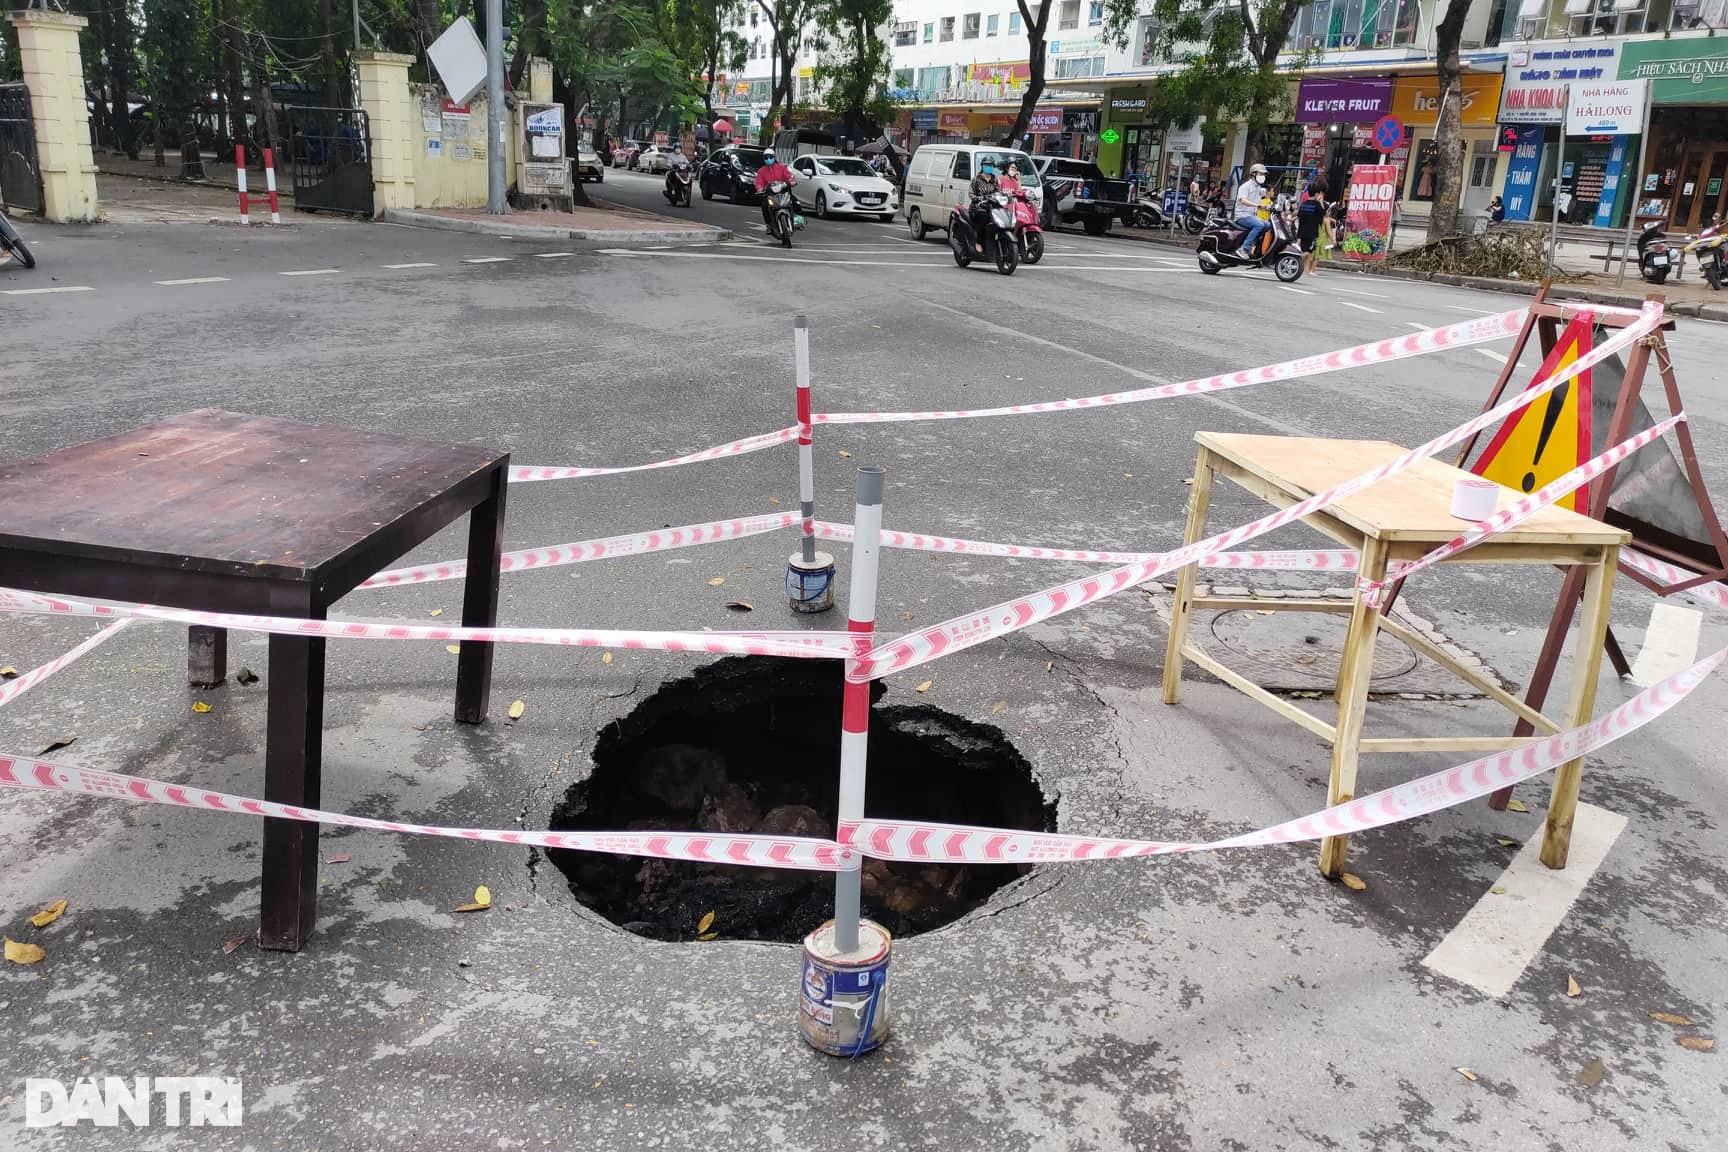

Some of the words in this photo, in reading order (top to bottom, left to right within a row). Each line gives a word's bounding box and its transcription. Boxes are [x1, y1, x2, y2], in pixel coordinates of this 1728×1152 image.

[1506, 88, 1526, 108] NHA
[1528, 88, 1554, 108] KHOA
[1305, 100, 1345, 112] KLEVER
[1348, 99, 1381, 111] FRUIT
[1350, 184, 1393, 200] NHO
[1348, 201, 1390, 211] AUSTRALIA
